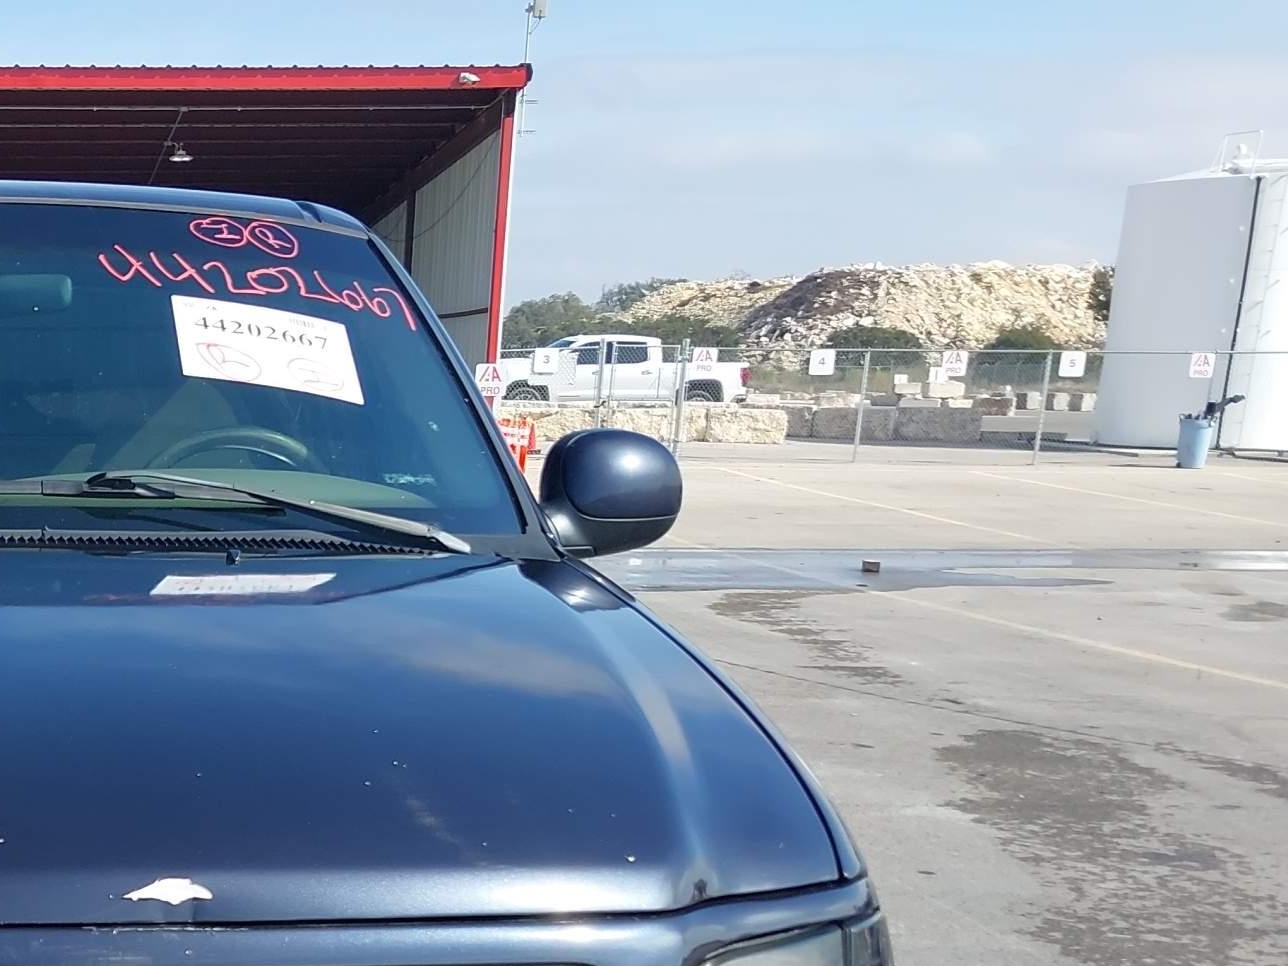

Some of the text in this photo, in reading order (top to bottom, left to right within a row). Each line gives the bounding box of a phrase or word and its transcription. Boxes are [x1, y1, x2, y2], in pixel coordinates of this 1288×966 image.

[98, 243, 417, 331] 44202667
[194, 315, 329, 350] 44202667
[543, 354, 550, 364] 3
[818, 356, 825, 365] 4
[1068, 359, 1076, 368] 5
[696, 364, 712, 372] PRO
[480, 386, 500, 395] PRO
